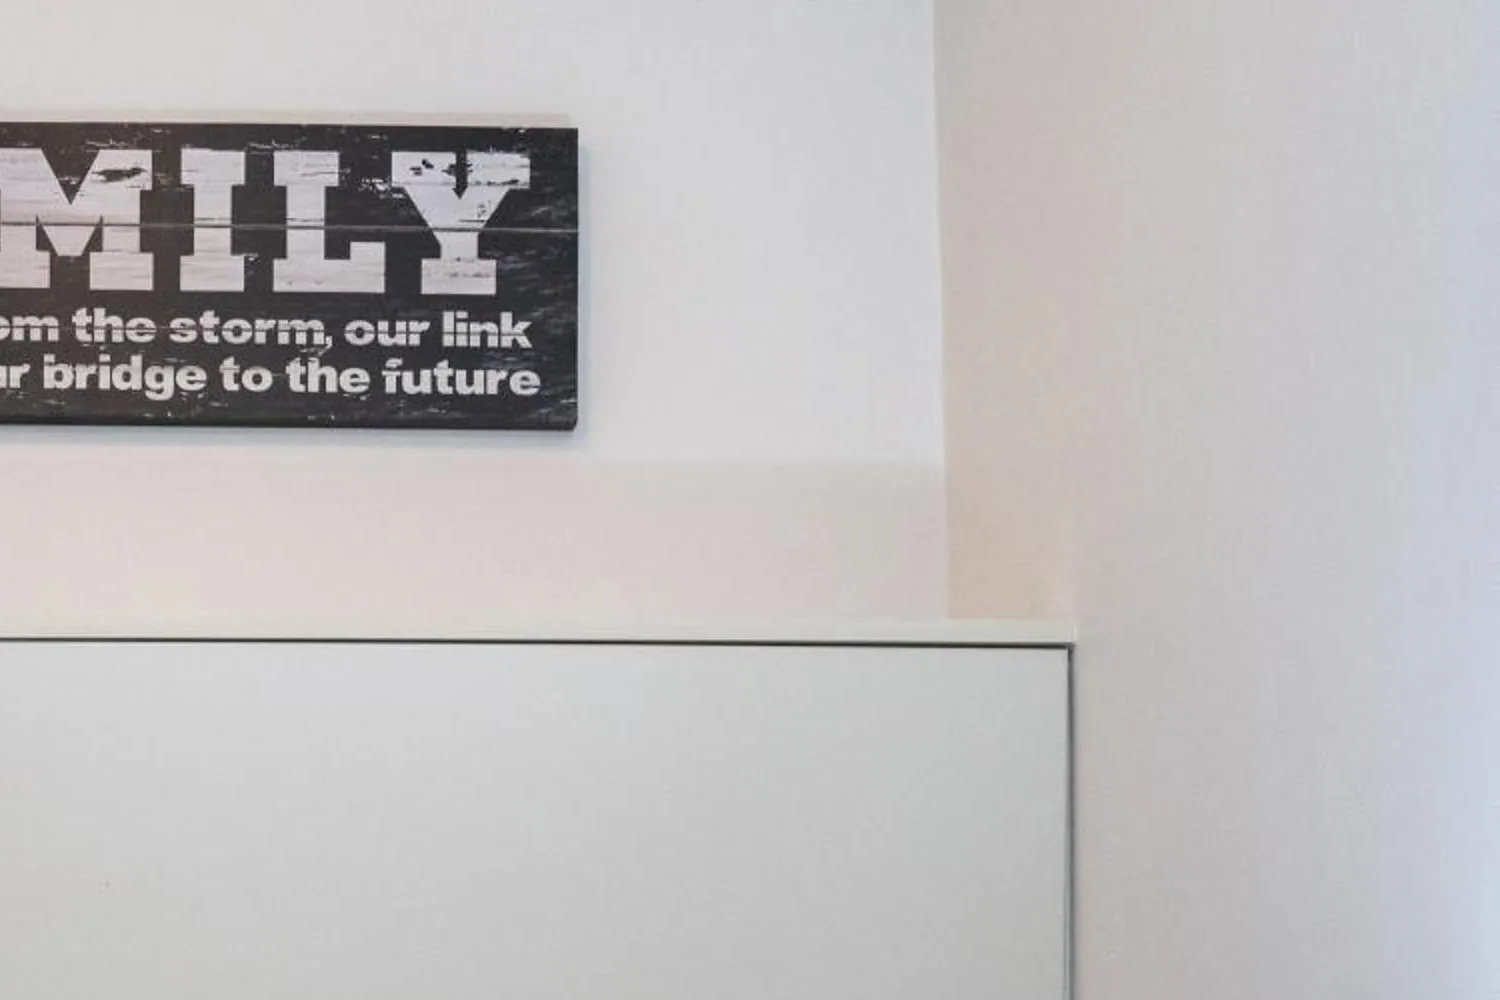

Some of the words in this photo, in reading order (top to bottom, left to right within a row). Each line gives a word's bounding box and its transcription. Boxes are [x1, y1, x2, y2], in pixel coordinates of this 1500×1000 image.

[71, 307, 158, 345] the
[168, 308, 335, 349] storm,
[344, 317, 431, 346] our
[441, 310, 534, 350] link
[42, 353, 208, 401] bridge
[219, 356, 274, 394] to
[284, 356, 372, 395] the
[381, 357, 542, 397] future
